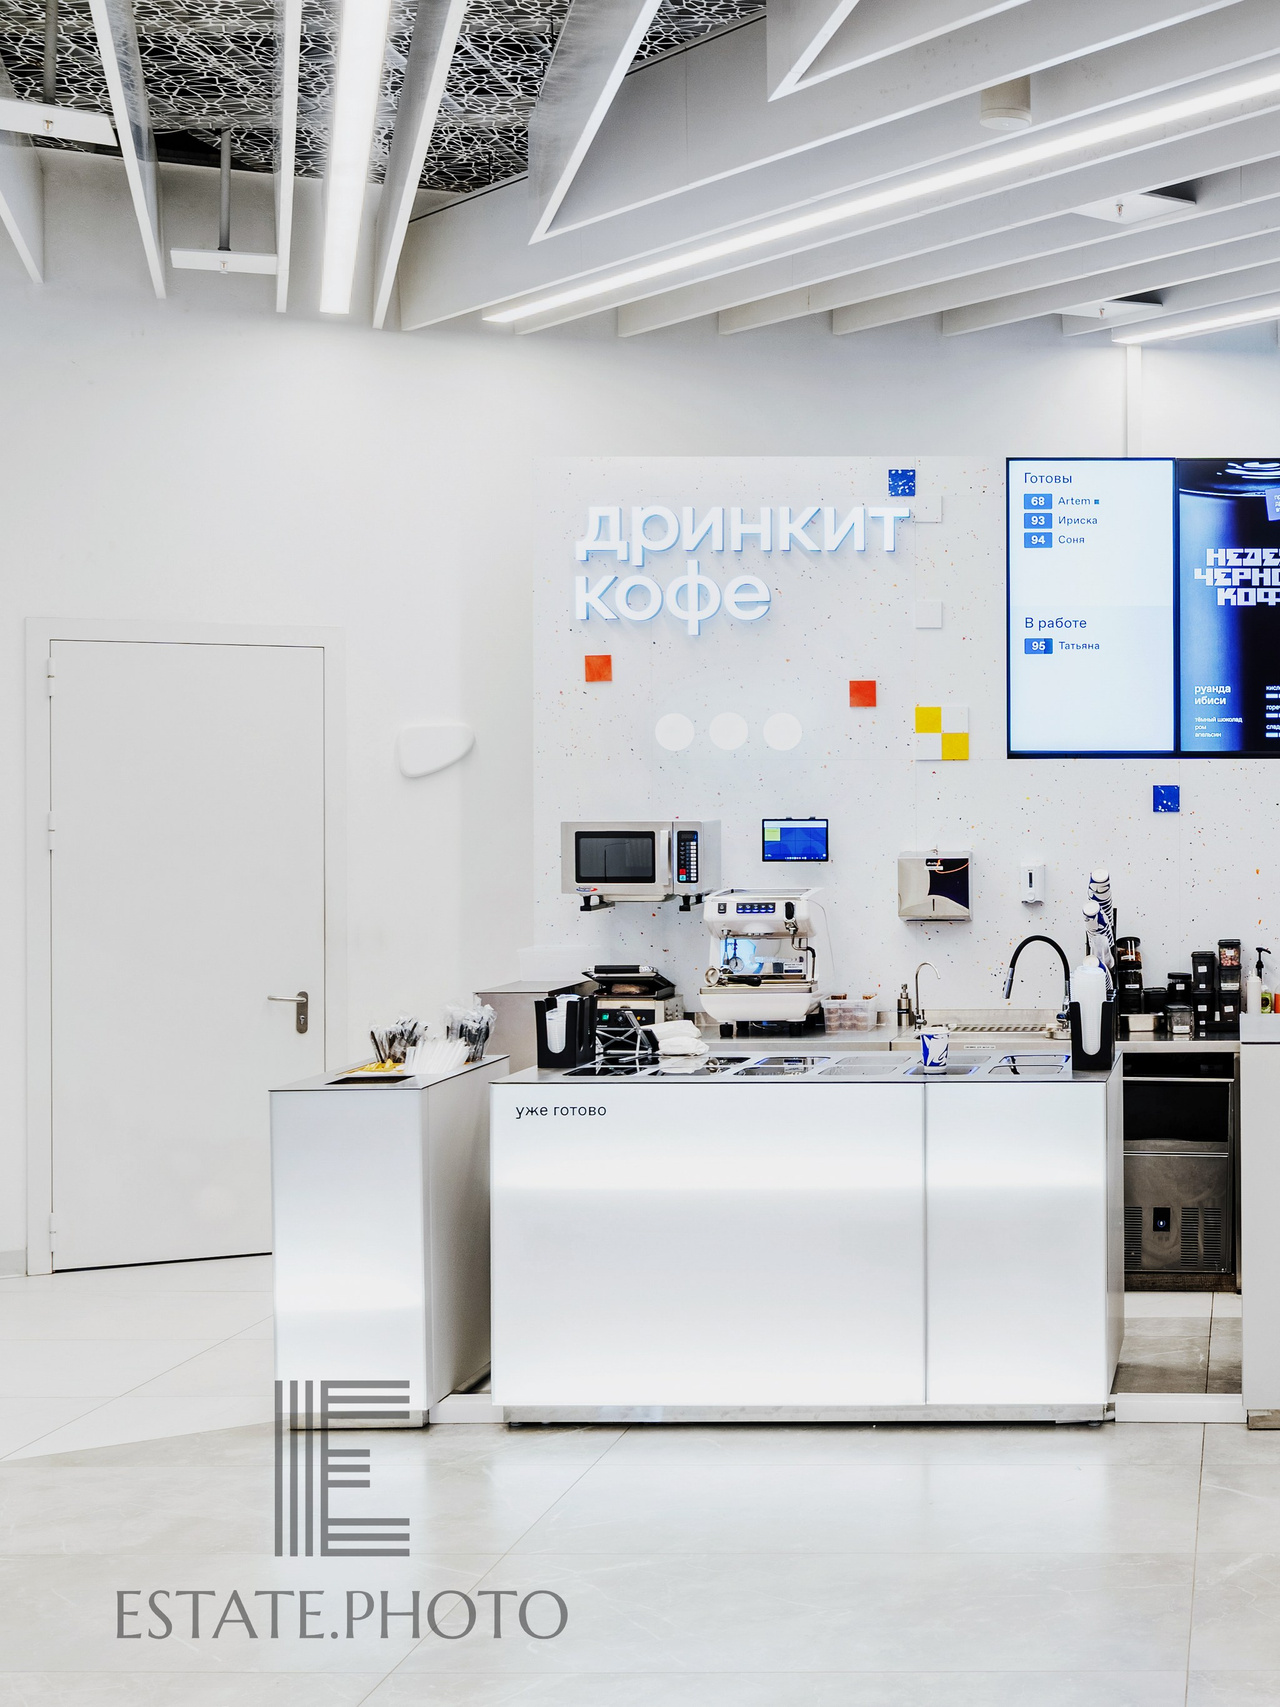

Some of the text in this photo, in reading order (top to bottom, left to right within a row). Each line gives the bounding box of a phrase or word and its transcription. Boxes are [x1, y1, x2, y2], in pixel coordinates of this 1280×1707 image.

[1023, 472, 1073, 485] Готовы
[1030, 496, 1091, 507] 68 Artem
[1030, 515, 1098, 526] 93 Ириска
[575, 505, 911, 567] дринкит
[1030, 534, 1085, 545] 94 Соня
[574, 559, 772, 637] кофе
[1025, 616, 1087, 631] В работе
[1031, 641, 1100, 652] 95 Татьяна
[1194, 685, 1231, 695] руанда
[1194, 695, 1226, 705] ибиси
[515, 1105, 607, 1120] уже готово
